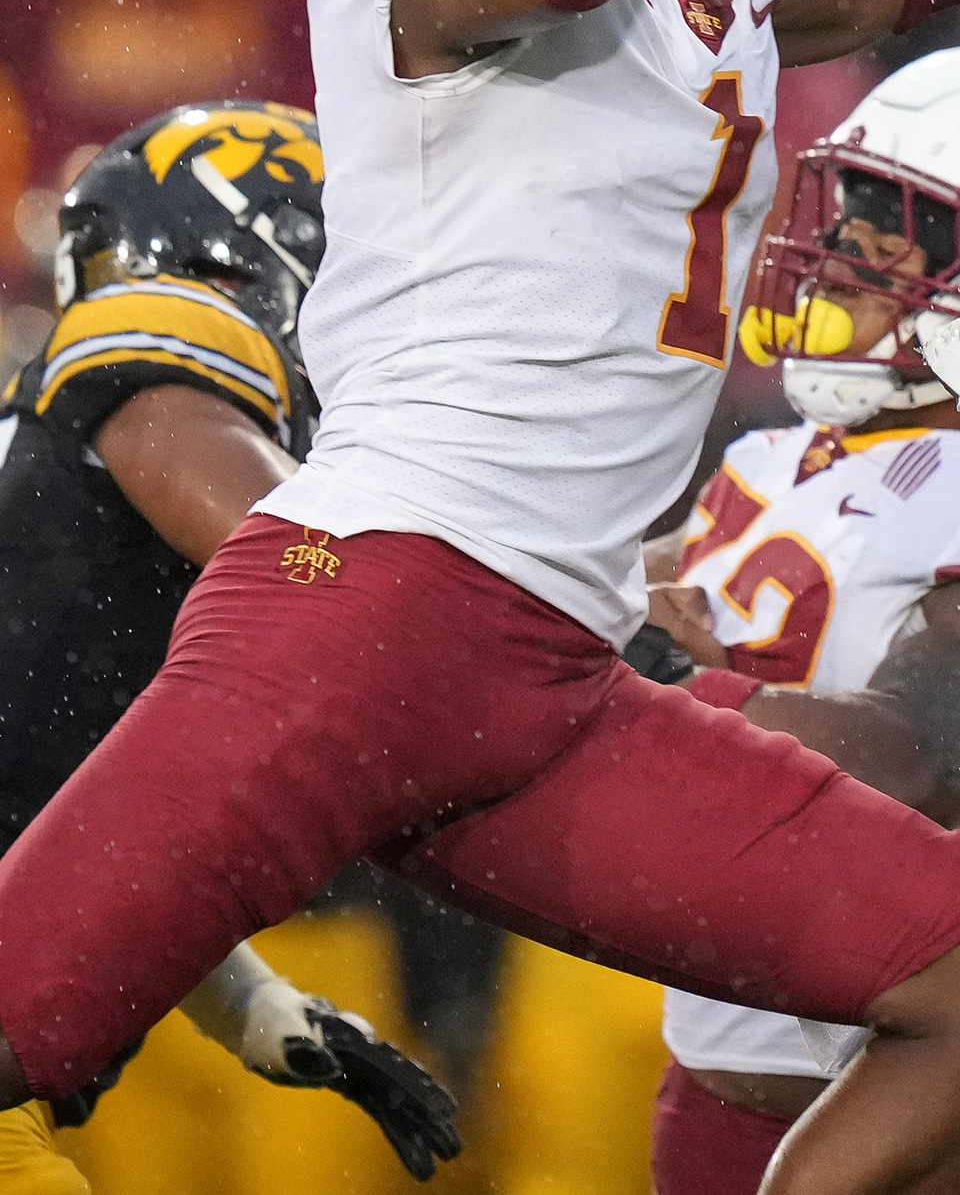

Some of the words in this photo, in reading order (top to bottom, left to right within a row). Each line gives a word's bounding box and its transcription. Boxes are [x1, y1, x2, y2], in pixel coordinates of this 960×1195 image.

[656, 70, 765, 370] 1
[280, 544, 341, 579] STATE
[677, 460, 836, 689] 72
